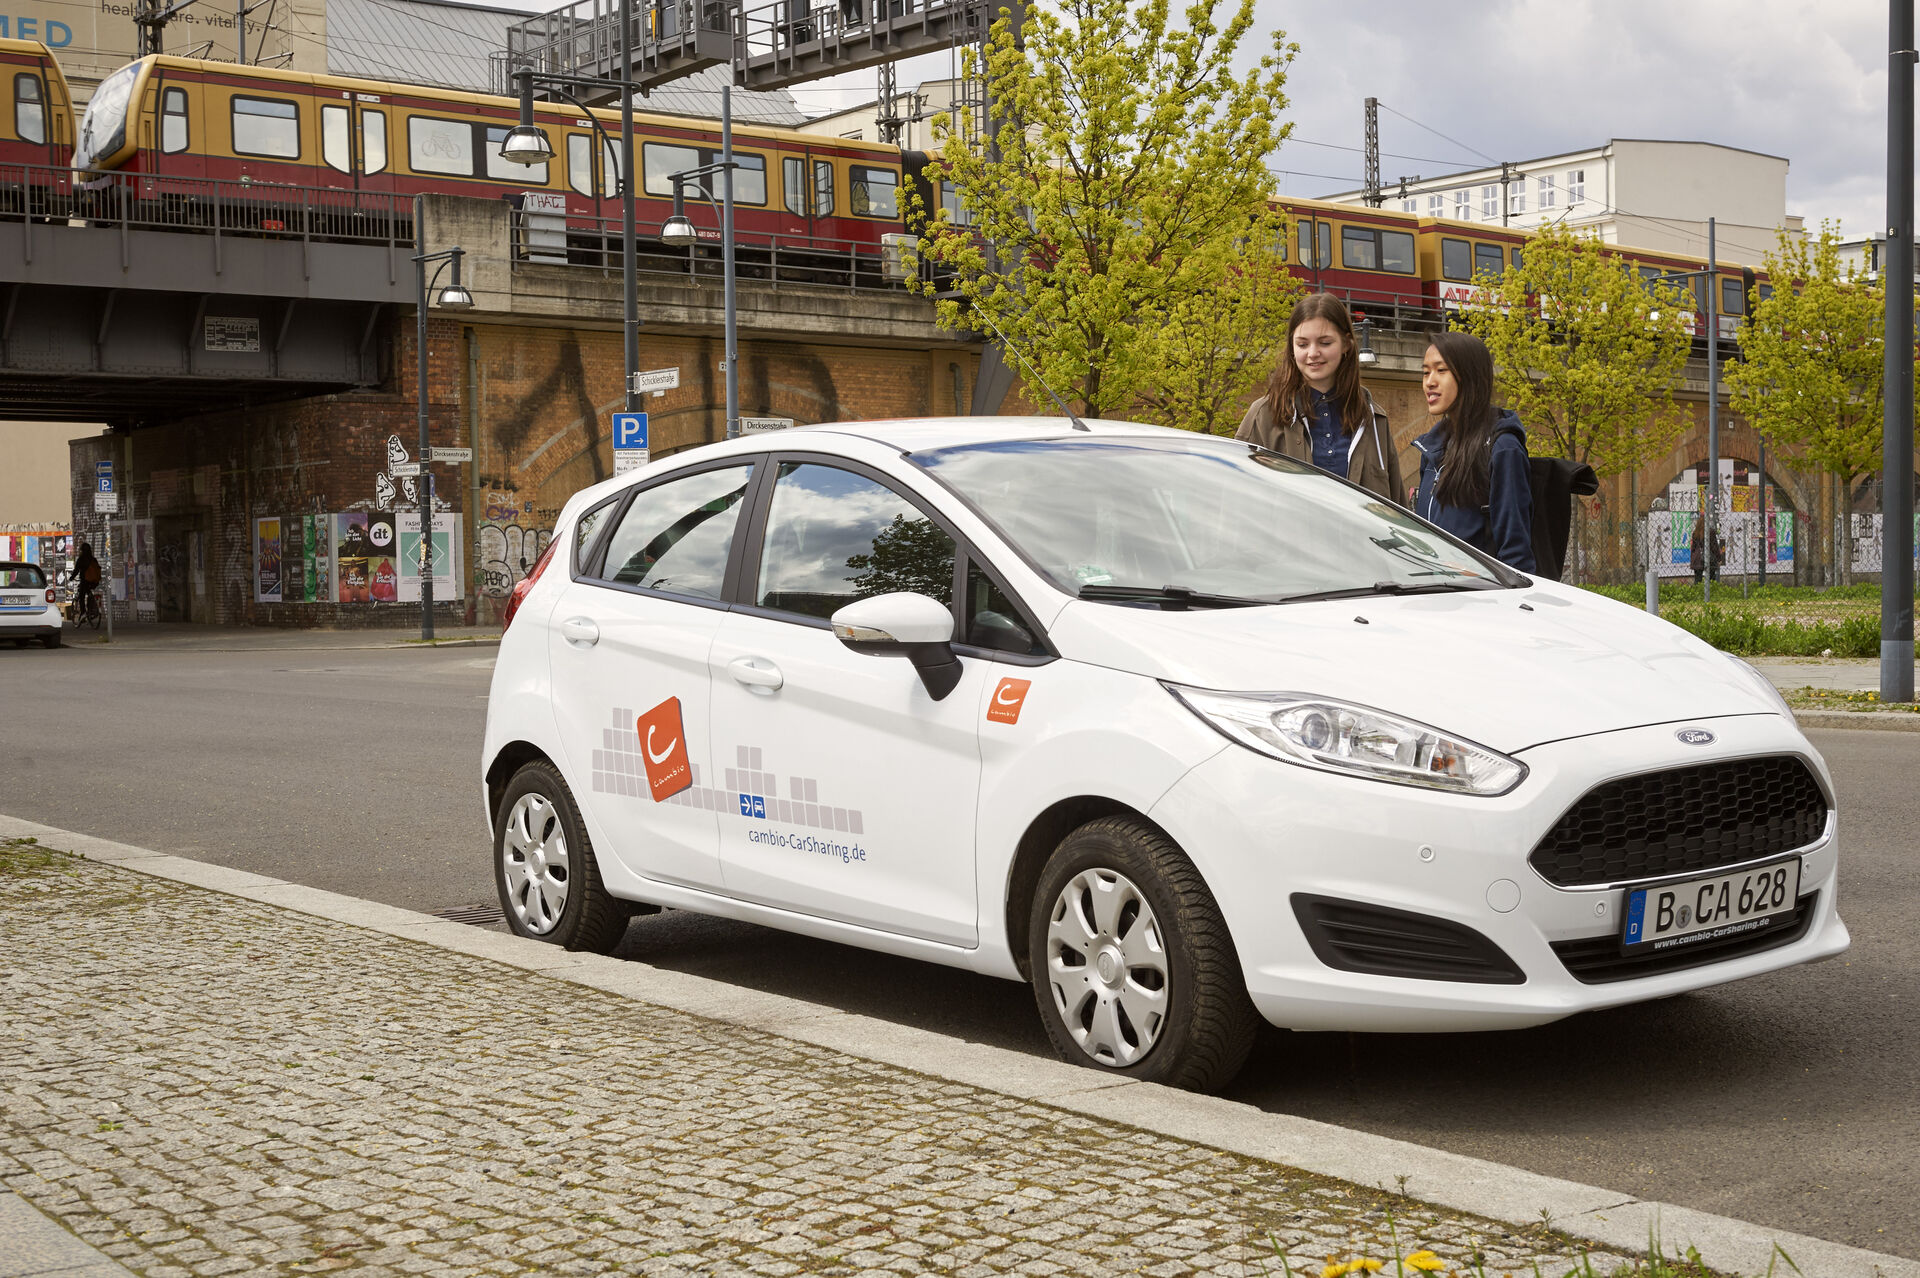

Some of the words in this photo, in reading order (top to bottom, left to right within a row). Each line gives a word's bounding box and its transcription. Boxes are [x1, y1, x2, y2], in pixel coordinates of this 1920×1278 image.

[620, 417, 640, 445] P
[101, 479, 110, 490] P
[373, 528, 389, 539] dt
[1685, 731, 1710, 743] Ford
[748, 829, 867, 864] cambio-CarSharing.de
[1655, 891, 1676, 933] B
[1695, 881, 1730, 924] CA
[1738, 868, 1787, 915] 628
[1630, 922, 1637, 934] D
